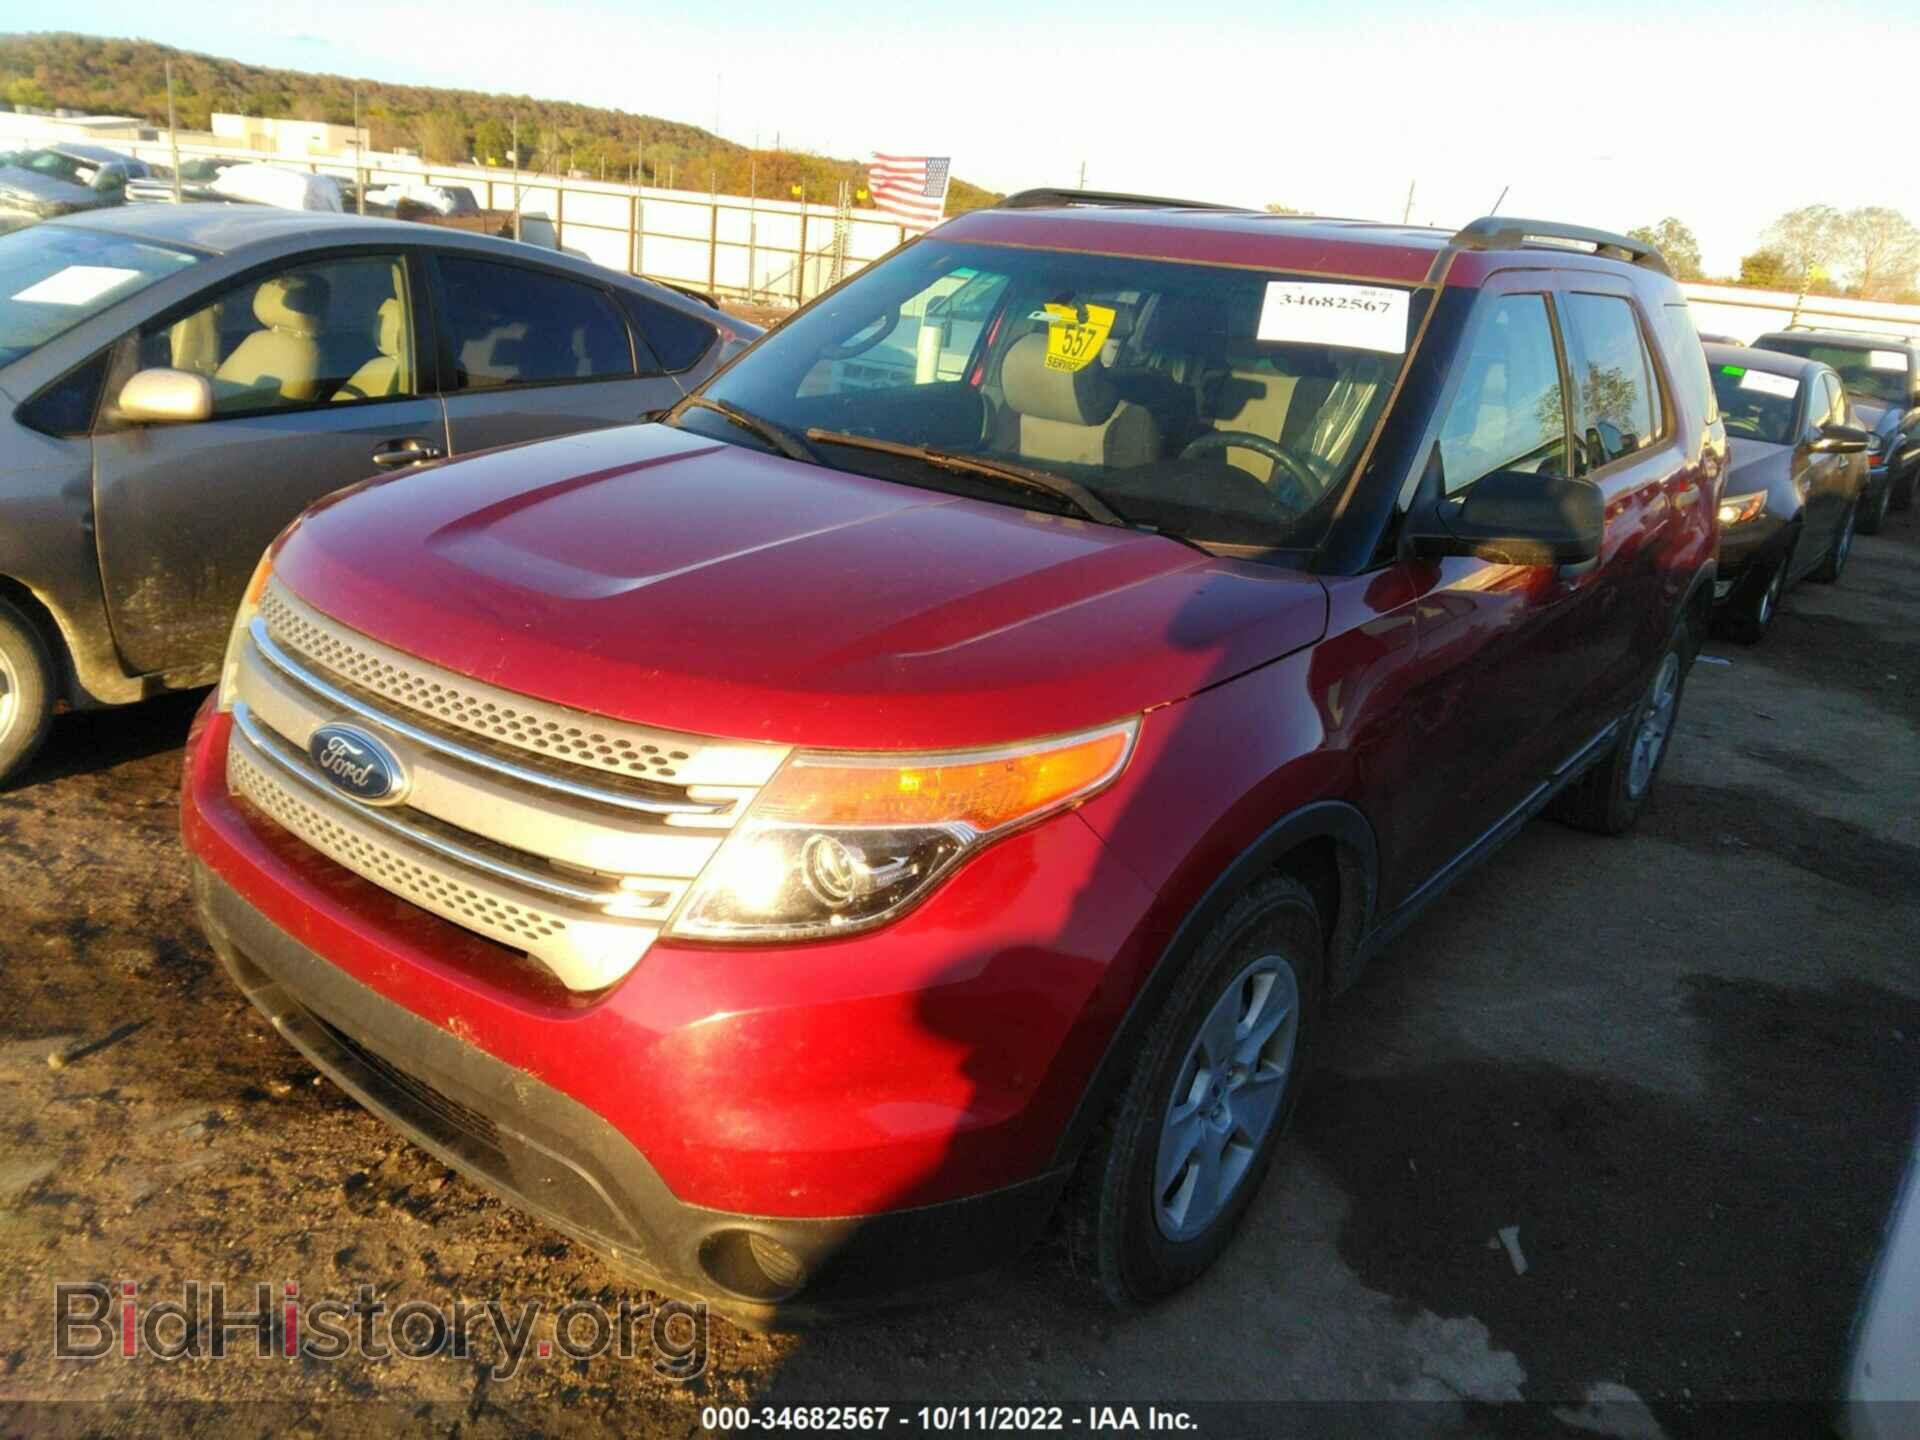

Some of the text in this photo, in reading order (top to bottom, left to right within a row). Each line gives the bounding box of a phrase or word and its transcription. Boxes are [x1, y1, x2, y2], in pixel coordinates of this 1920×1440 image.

[1279, 293, 1391, 314] 34682567
[1061, 324, 1097, 357] 557
[320, 736, 374, 786] Ford
